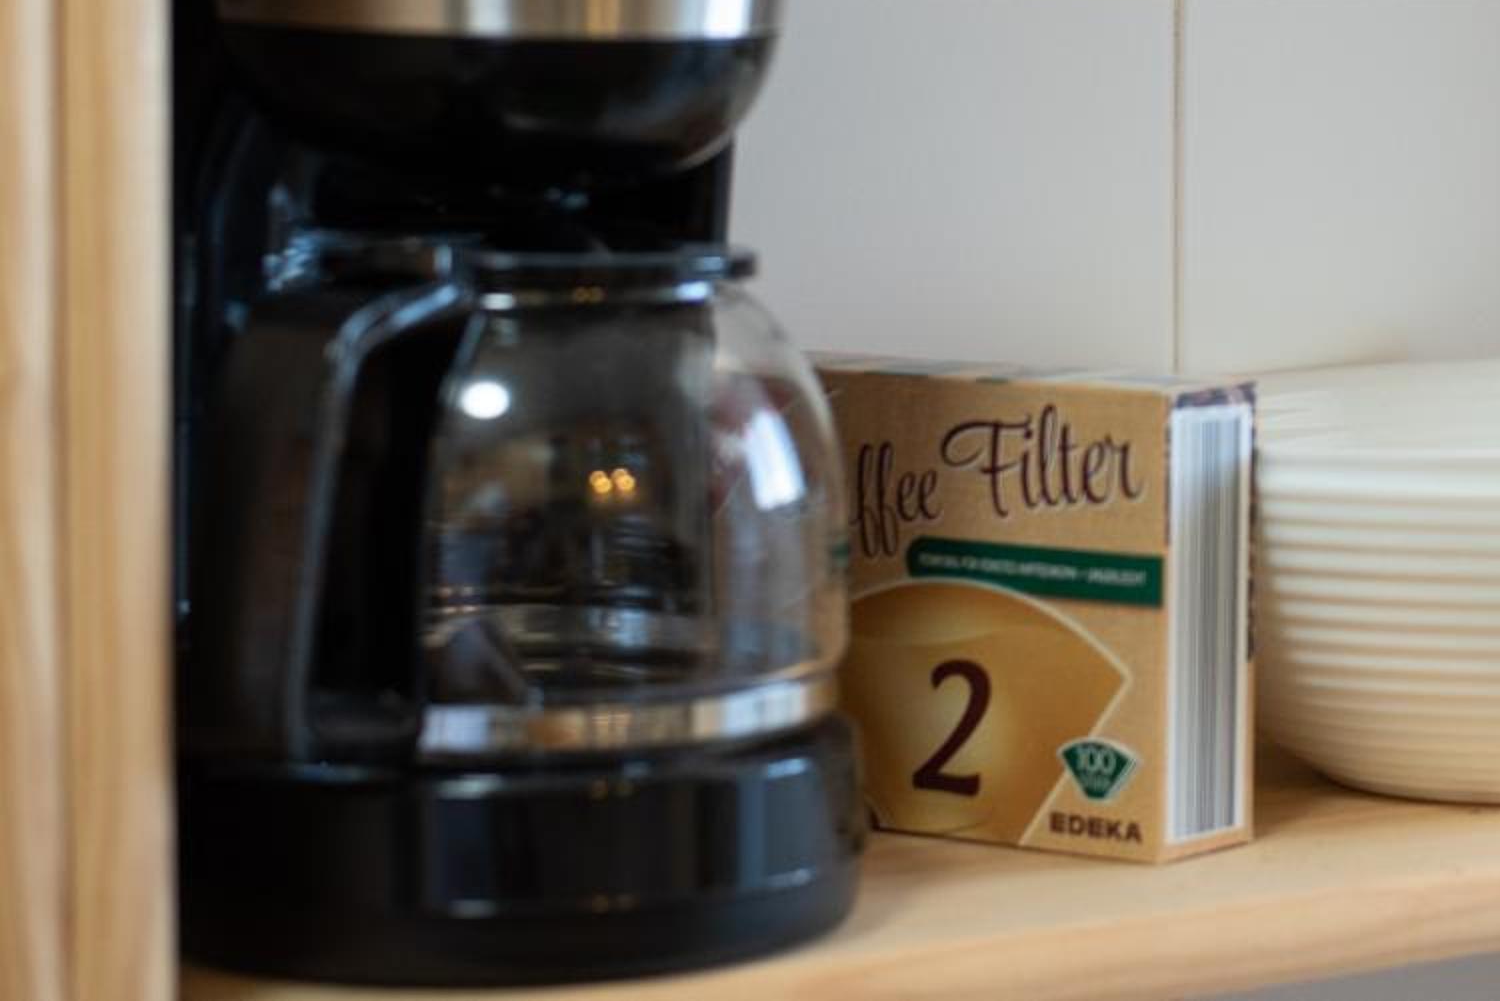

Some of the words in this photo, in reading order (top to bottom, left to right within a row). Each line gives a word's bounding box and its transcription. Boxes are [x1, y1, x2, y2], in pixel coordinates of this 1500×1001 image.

[850, 440, 939, 558] ffee
[940, 404, 1144, 517] Filter
[912, 658, 992, 797] 2
[1076, 747, 1117, 776] 100
[1050, 811, 1144, 845] EDEKA
